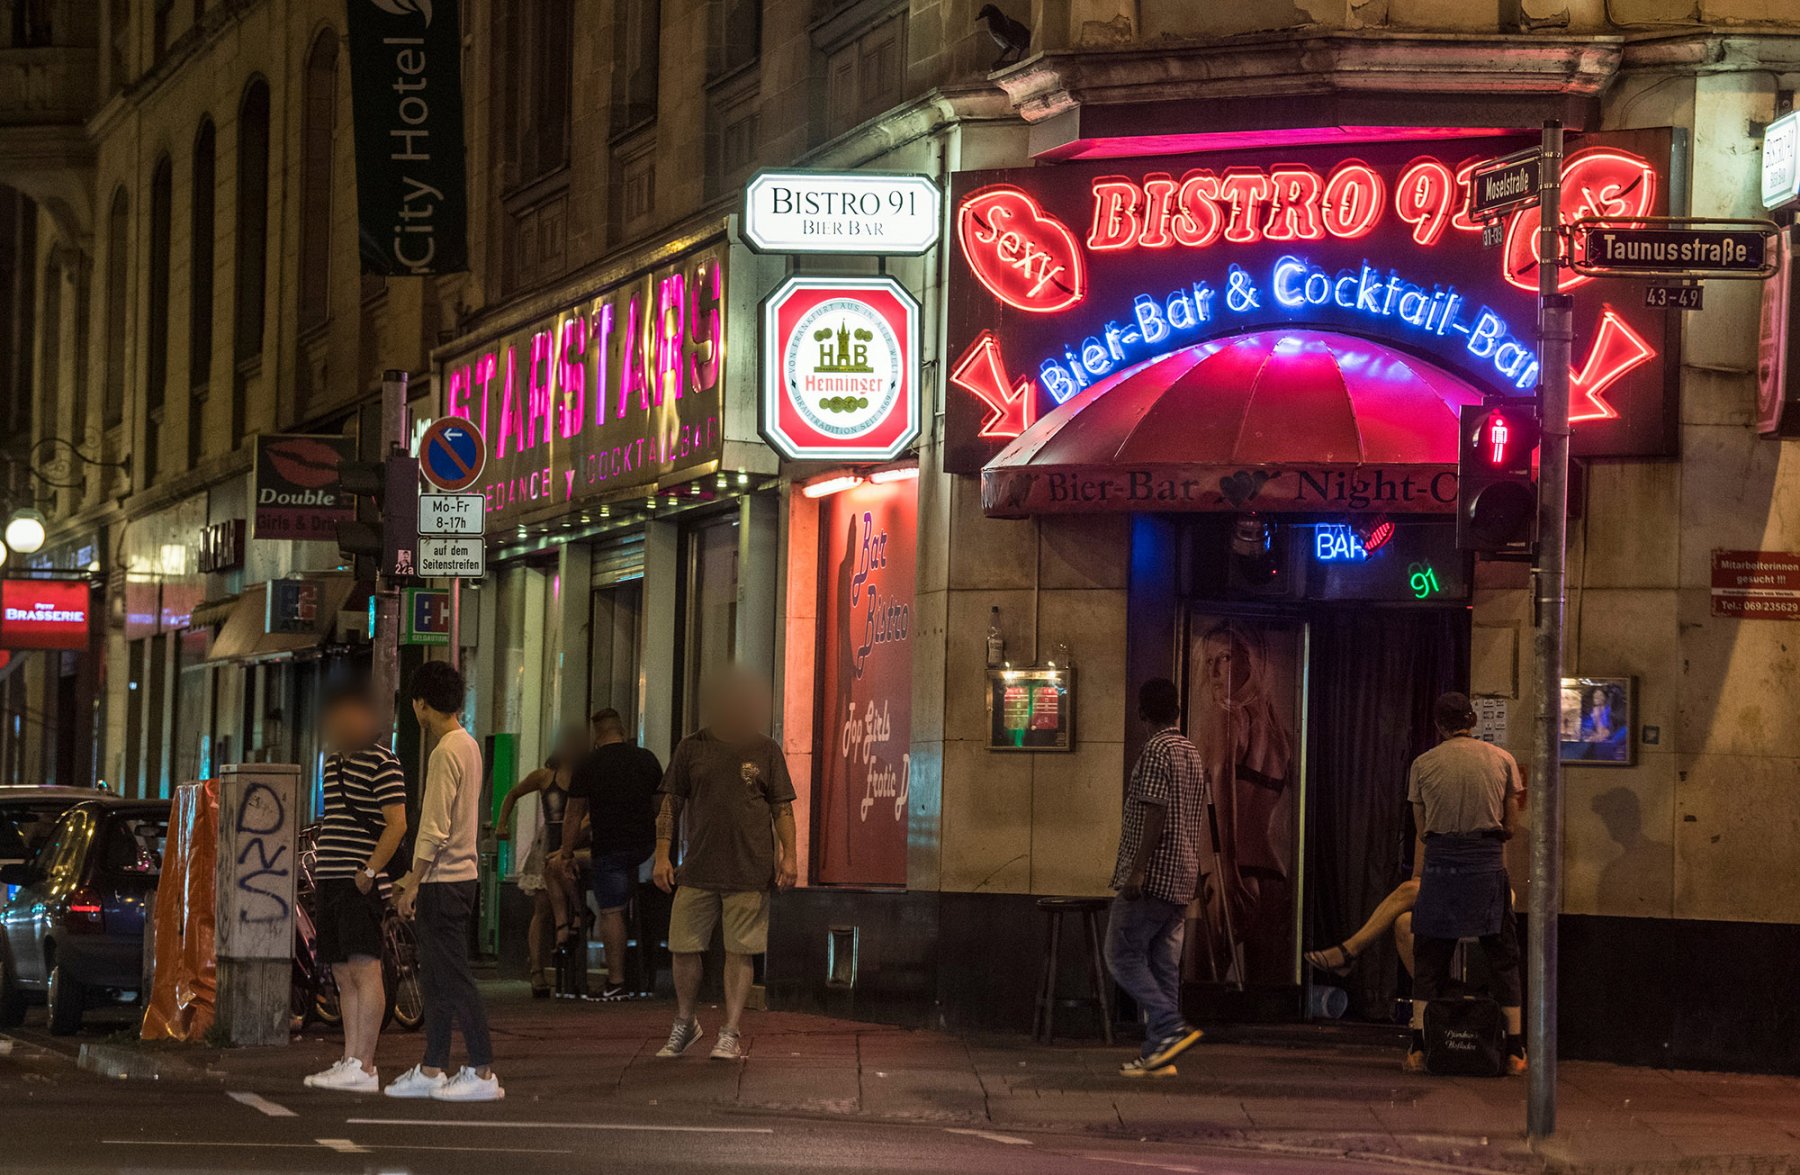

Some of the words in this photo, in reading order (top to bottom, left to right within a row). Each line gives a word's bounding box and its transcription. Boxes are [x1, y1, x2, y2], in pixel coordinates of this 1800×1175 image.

[383, 38, 430, 160] Hotel
[1486, 167, 1529, 202] Moselstraße
[771, 187, 881, 216] BISTRO
[888, 190, 916, 216] 91
[1087, 164, 1384, 250] BISTRO
[394, 176, 444, 267] City
[803, 219, 844, 236] BIER
[849, 220, 884, 236] BAR
[975, 205, 1065, 298] Sexy
[1603, 233, 1747, 266] Taunusstraße
[840, 302, 860, 312] AUS
[1647, 288, 1699, 307] 43-49
[792, 303, 834, 350] FRANKFURT
[875, 320, 892, 346] ALLE
[1040, 281, 1215, 404] Bier-Bar
[1226, 266, 1260, 312] &
[1274, 259, 1538, 388] Cocktail-Bar
[788, 350, 797, 374] VON
[889, 348, 899, 375] WELT
[805, 375, 883, 394] Henninger
[794, 394, 858, 436] BRAUTRADITION
[860, 414, 879, 430] SEIT
[879, 394, 892, 414] 1869
[587, 417, 717, 484] COCKTAILBAR
[259, 487, 336, 506] Double
[1046, 470, 1198, 502] Bier-Bar
[433, 501, 470, 513] Mo-Fr
[257, 514, 290, 531] Girls
[296, 516, 306, 531] &
[436, 516, 467, 529] 8-17h
[433, 545, 448, 556] auf
[451, 545, 468, 556] dem
[1317, 528, 1368, 560] BAR
[395, 563, 415, 575] 22a
[422, 558, 480, 571] Seitenstreifen
[852, 511, 888, 608] Bar
[1721, 560, 1799, 571] Mitarbeiterinnen
[1410, 567, 1439, 599] 91
[1736, 574, 1775, 585] gesucht
[5, 608, 85, 622] BRASSERIE
[856, 583, 910, 681] Bistro
[843, 701, 863, 764] Top
[863, 700, 891, 765] Girls
[861, 755, 896, 822] Erotic
